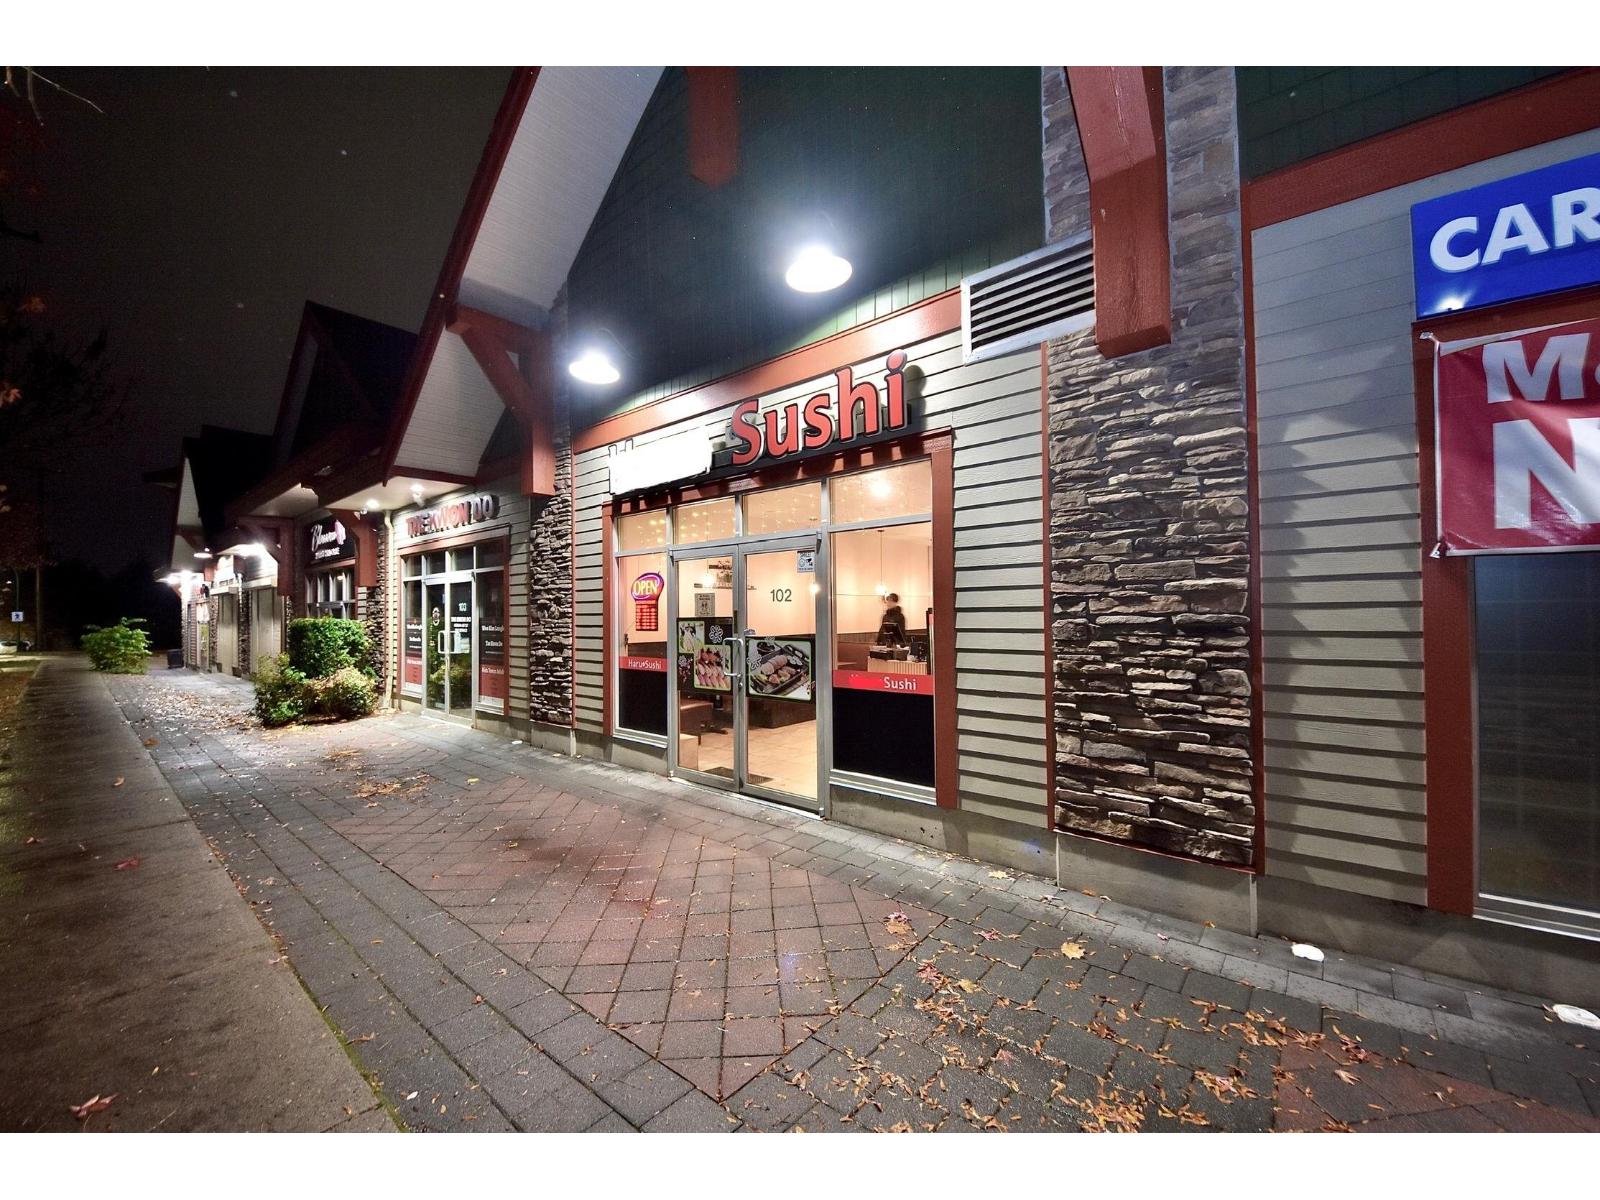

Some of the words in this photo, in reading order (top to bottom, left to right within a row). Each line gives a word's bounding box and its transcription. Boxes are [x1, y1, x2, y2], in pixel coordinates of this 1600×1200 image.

[1430, 187, 1600, 271] CAR
[1482, 333, 1600, 403] M
[729, 350, 907, 465] Sushi
[633, 580, 658, 596] OPEN
[770, 588, 792, 602] 102
[883, 676, 917, 691] Sushi
